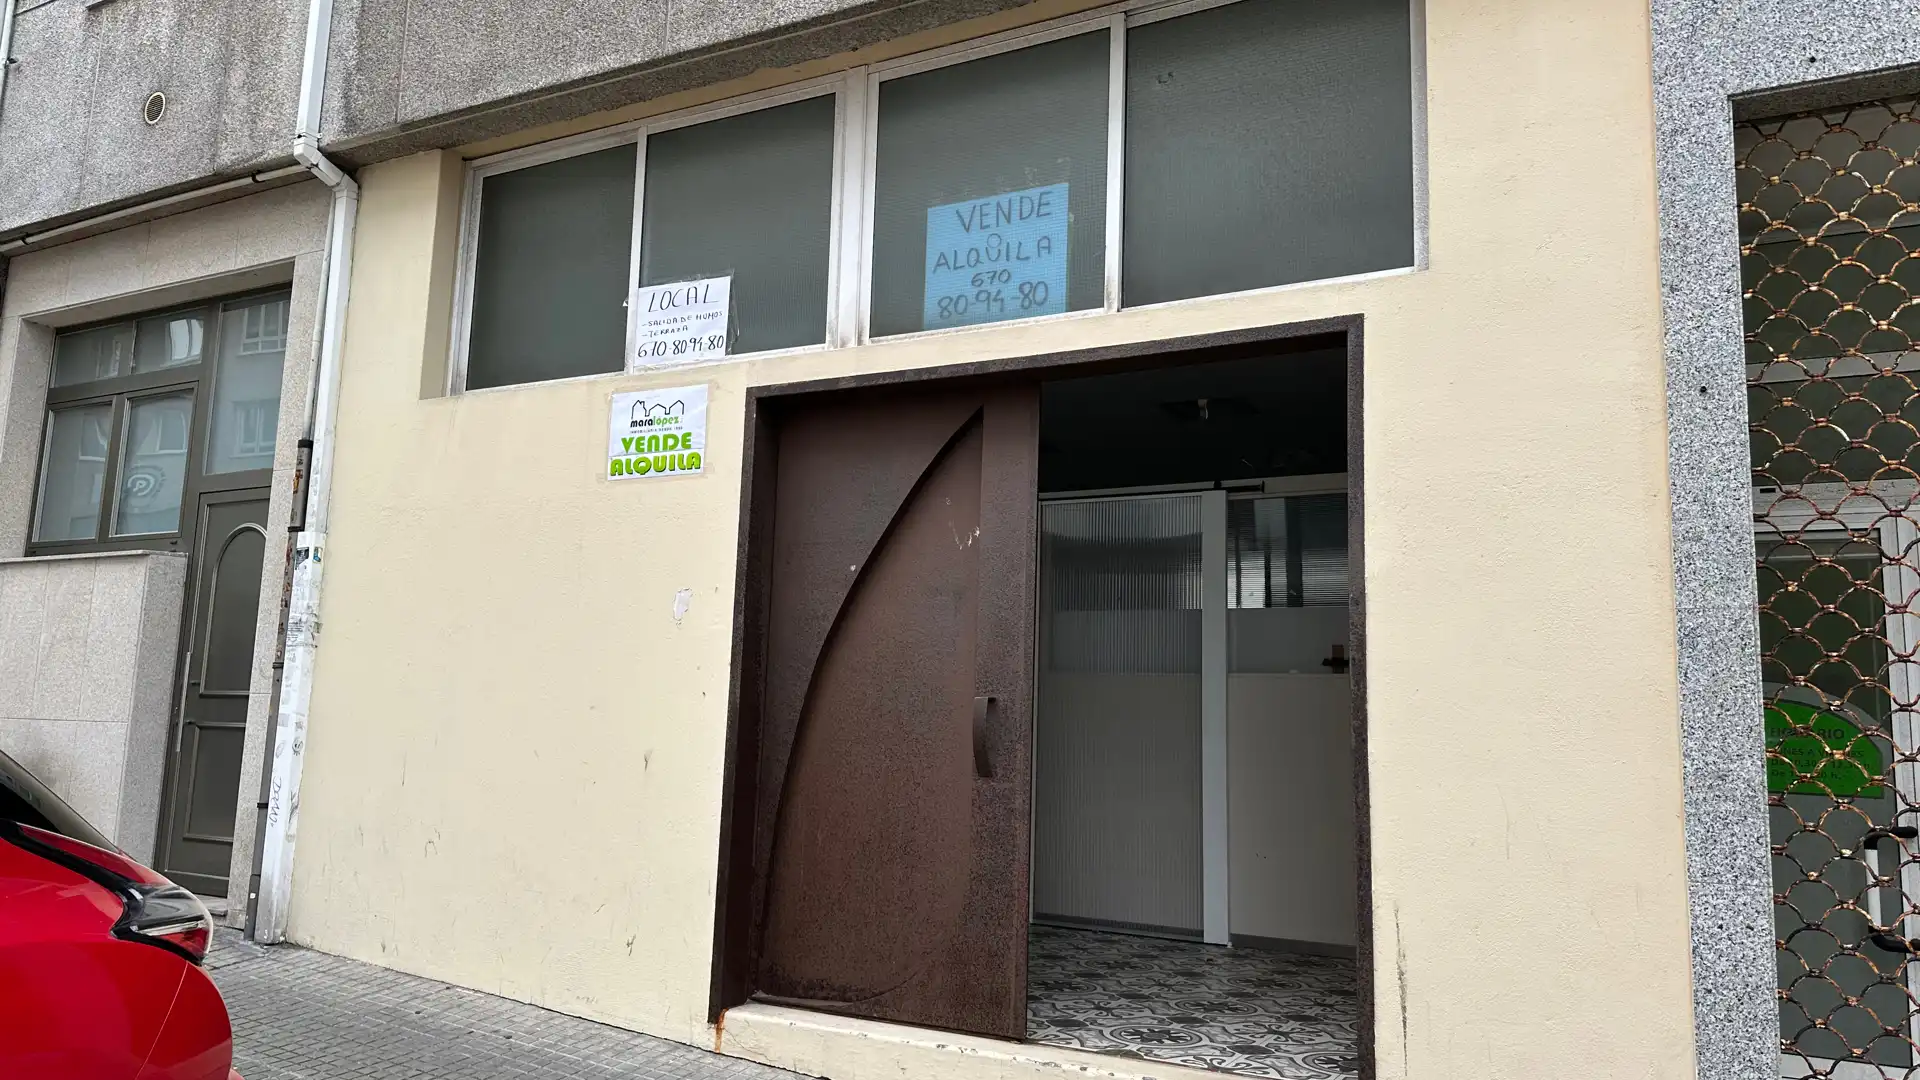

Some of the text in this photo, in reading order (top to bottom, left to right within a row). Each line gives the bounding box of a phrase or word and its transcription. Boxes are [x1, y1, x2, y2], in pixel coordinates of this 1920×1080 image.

[955, 190, 1053, 233] VENDE
[932, 235, 1052, 274] ALQUILA
[970, 268, 1012, 288] 670
[647, 283, 720, 313] LOCAL
[936, 280, 1049, 320] 80-94-80
[620, 431, 693, 454] VENDE
[609, 451, 702, 477] ALQUILA
